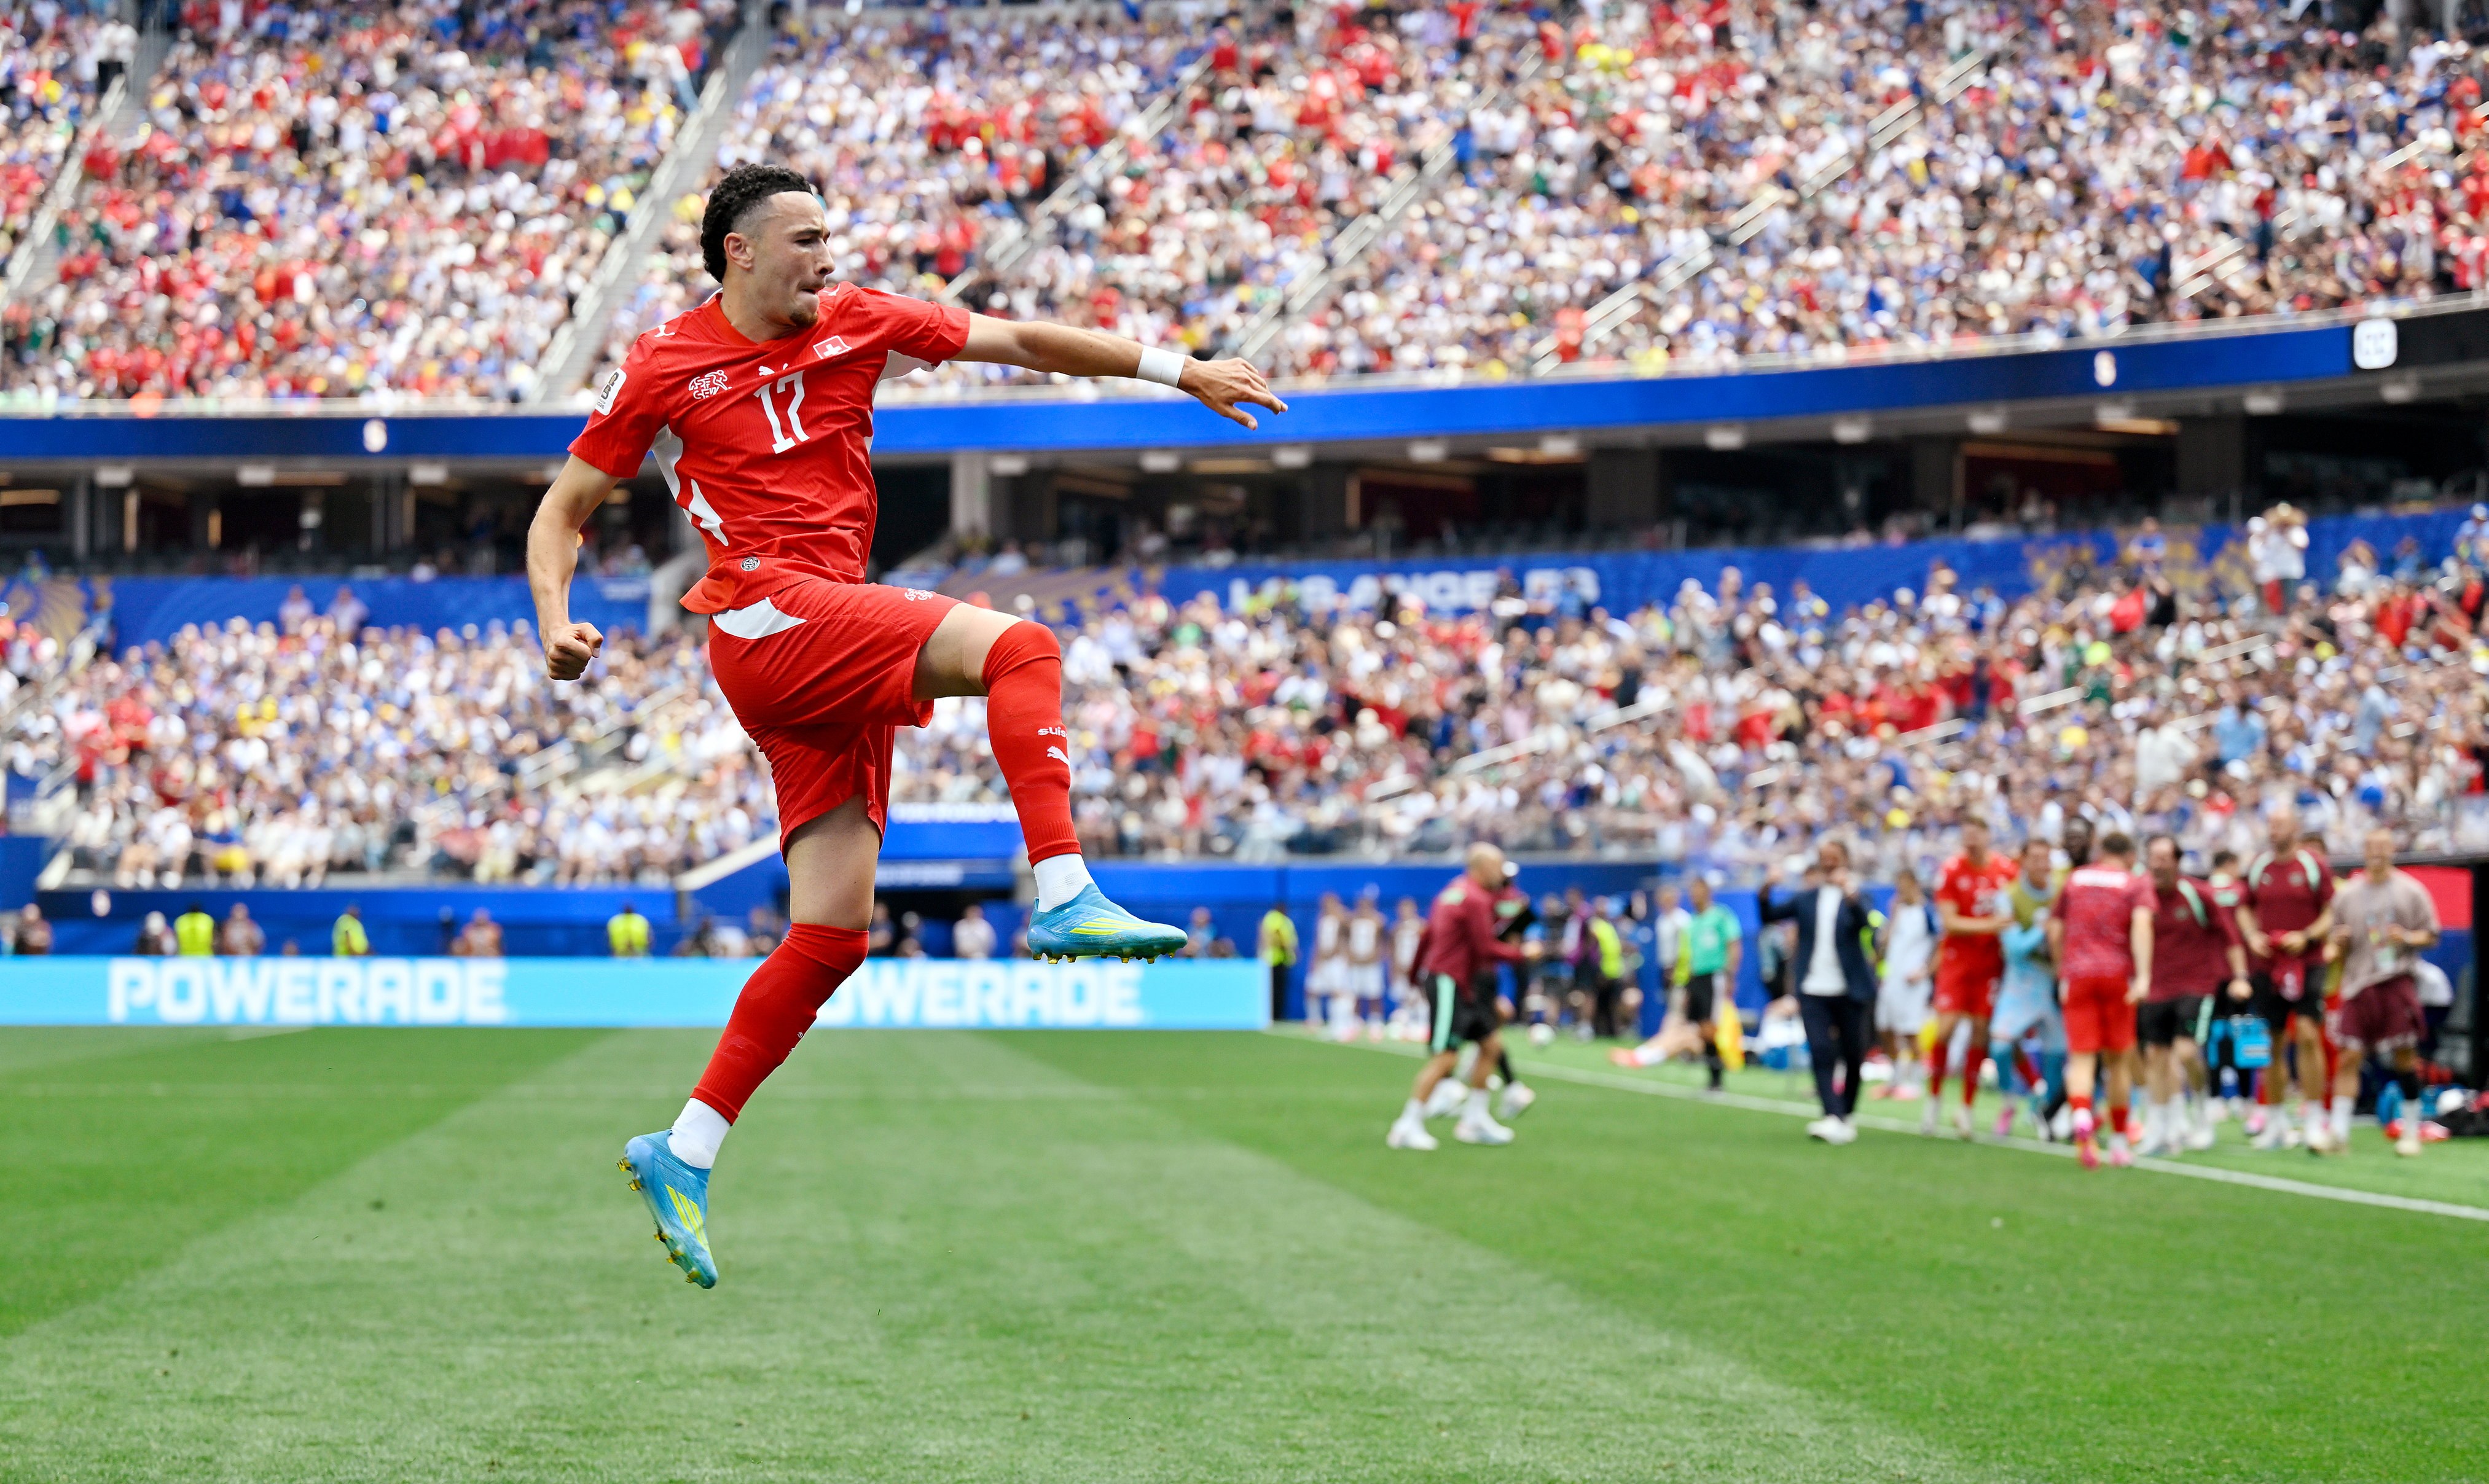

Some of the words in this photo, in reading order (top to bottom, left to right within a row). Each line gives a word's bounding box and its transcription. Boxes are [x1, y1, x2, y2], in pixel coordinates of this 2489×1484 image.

[753, 370, 810, 455] 17
[1038, 727, 1067, 738] suis
[108, 957, 508, 1023] POWERADE
[810, 959, 1143, 1026] WERADE
